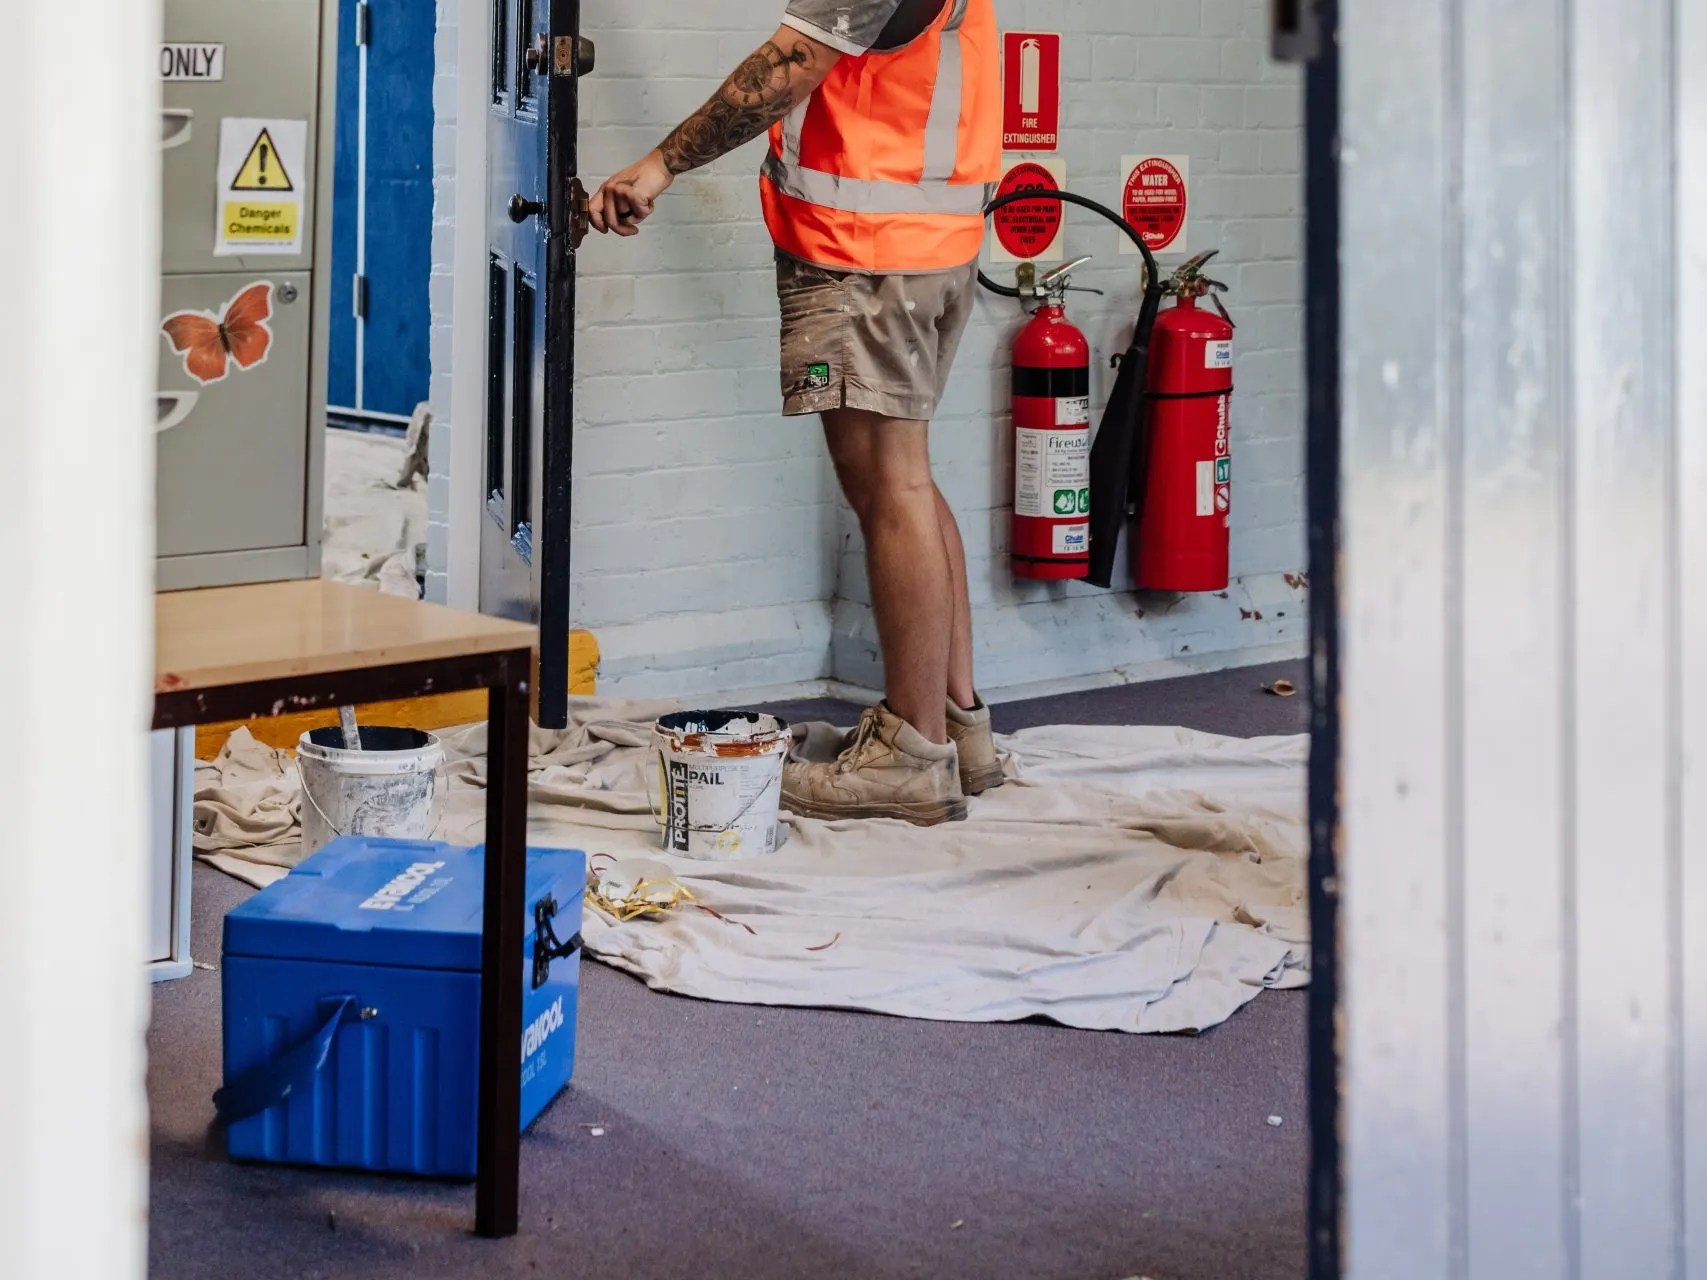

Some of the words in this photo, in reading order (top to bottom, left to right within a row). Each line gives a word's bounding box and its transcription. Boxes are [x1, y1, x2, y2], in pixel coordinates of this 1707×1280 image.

[162, 46, 217, 77] ONLY
[1022, 117, 1038, 128] FIRE
[1003, 132, 1056, 144] EXTINGUISHER
[1141, 173, 1169, 186] WATER
[239, 206, 282, 221] Danger
[228, 222, 291, 234] Chemicals
[1216, 394, 1226, 439] Chubb
[688, 771, 725, 786] PAIL
